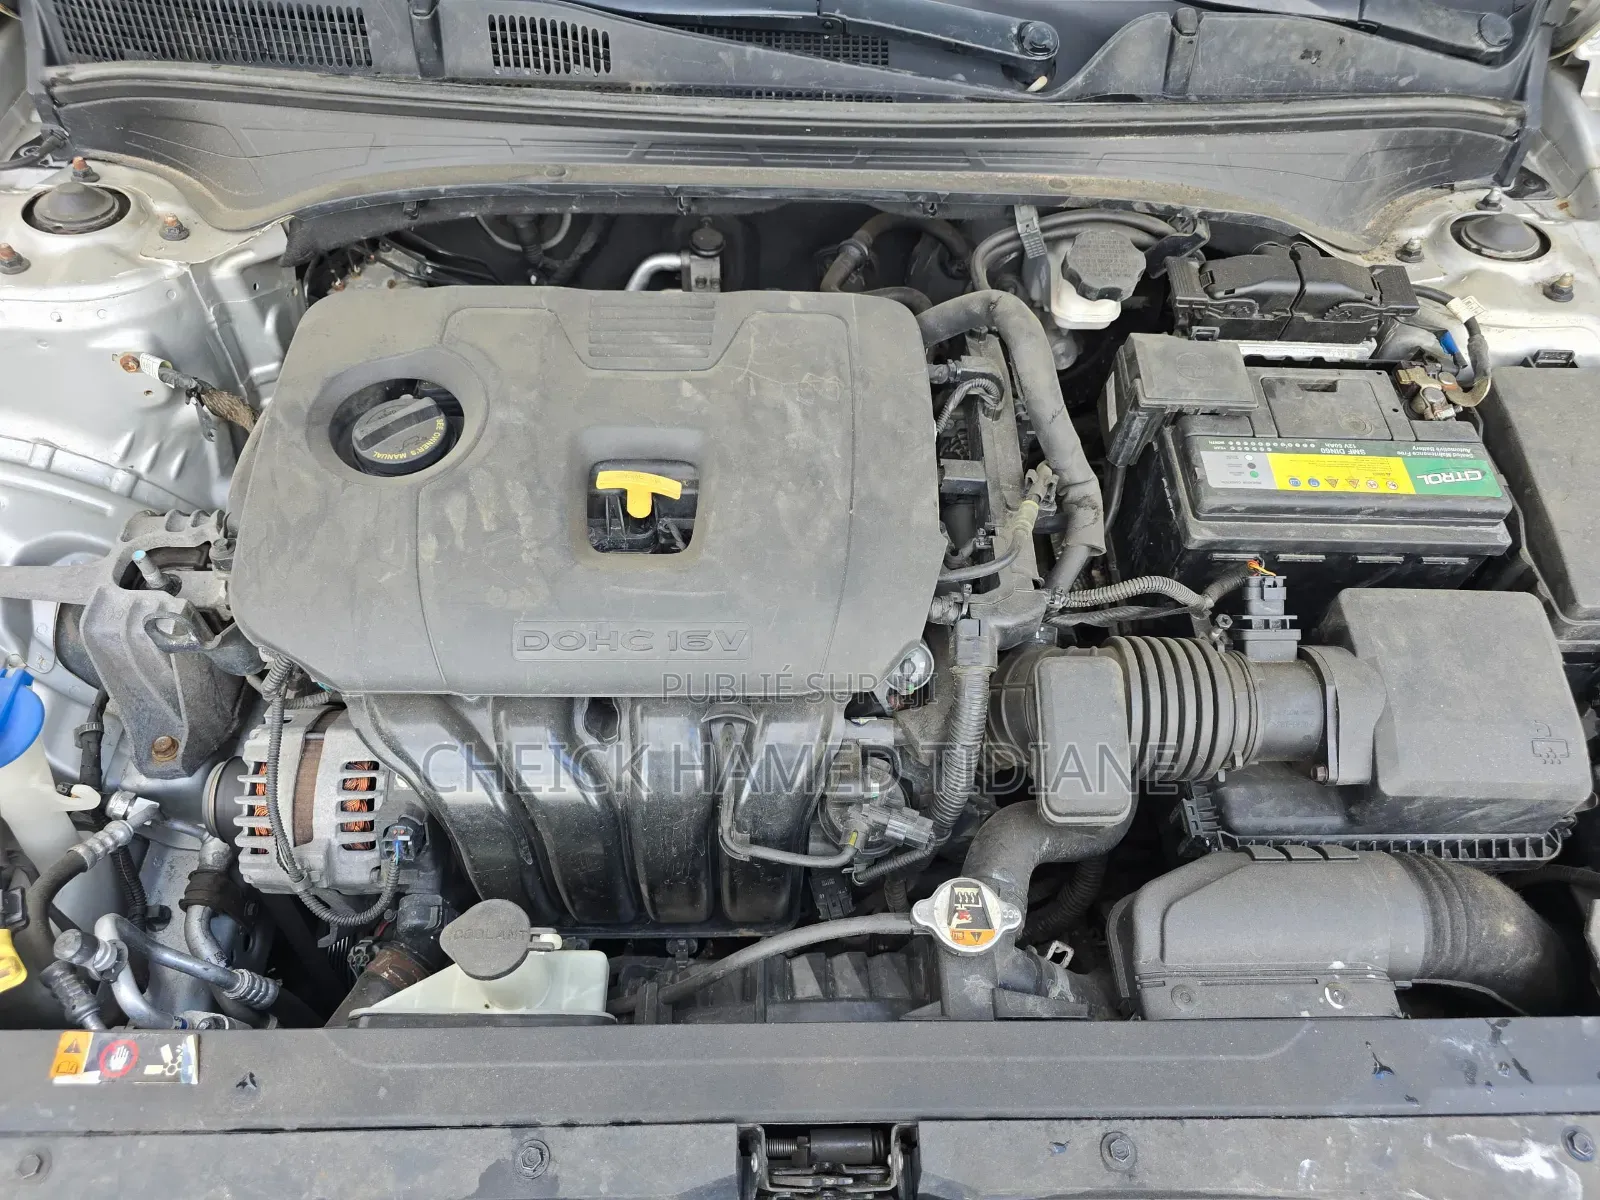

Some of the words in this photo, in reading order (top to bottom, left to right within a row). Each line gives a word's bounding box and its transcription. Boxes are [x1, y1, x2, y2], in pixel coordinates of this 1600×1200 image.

[436, 418, 445, 431] SEE
[410, 432, 441, 456] OWNER'S
[373, 450, 407, 460] MANUAL
[1416, 470, 1483, 485] CITROL
[516, 629, 655, 652] DOHC
[667, 629, 748, 652] 16V
[453, 927, 527, 940] COOLANT
